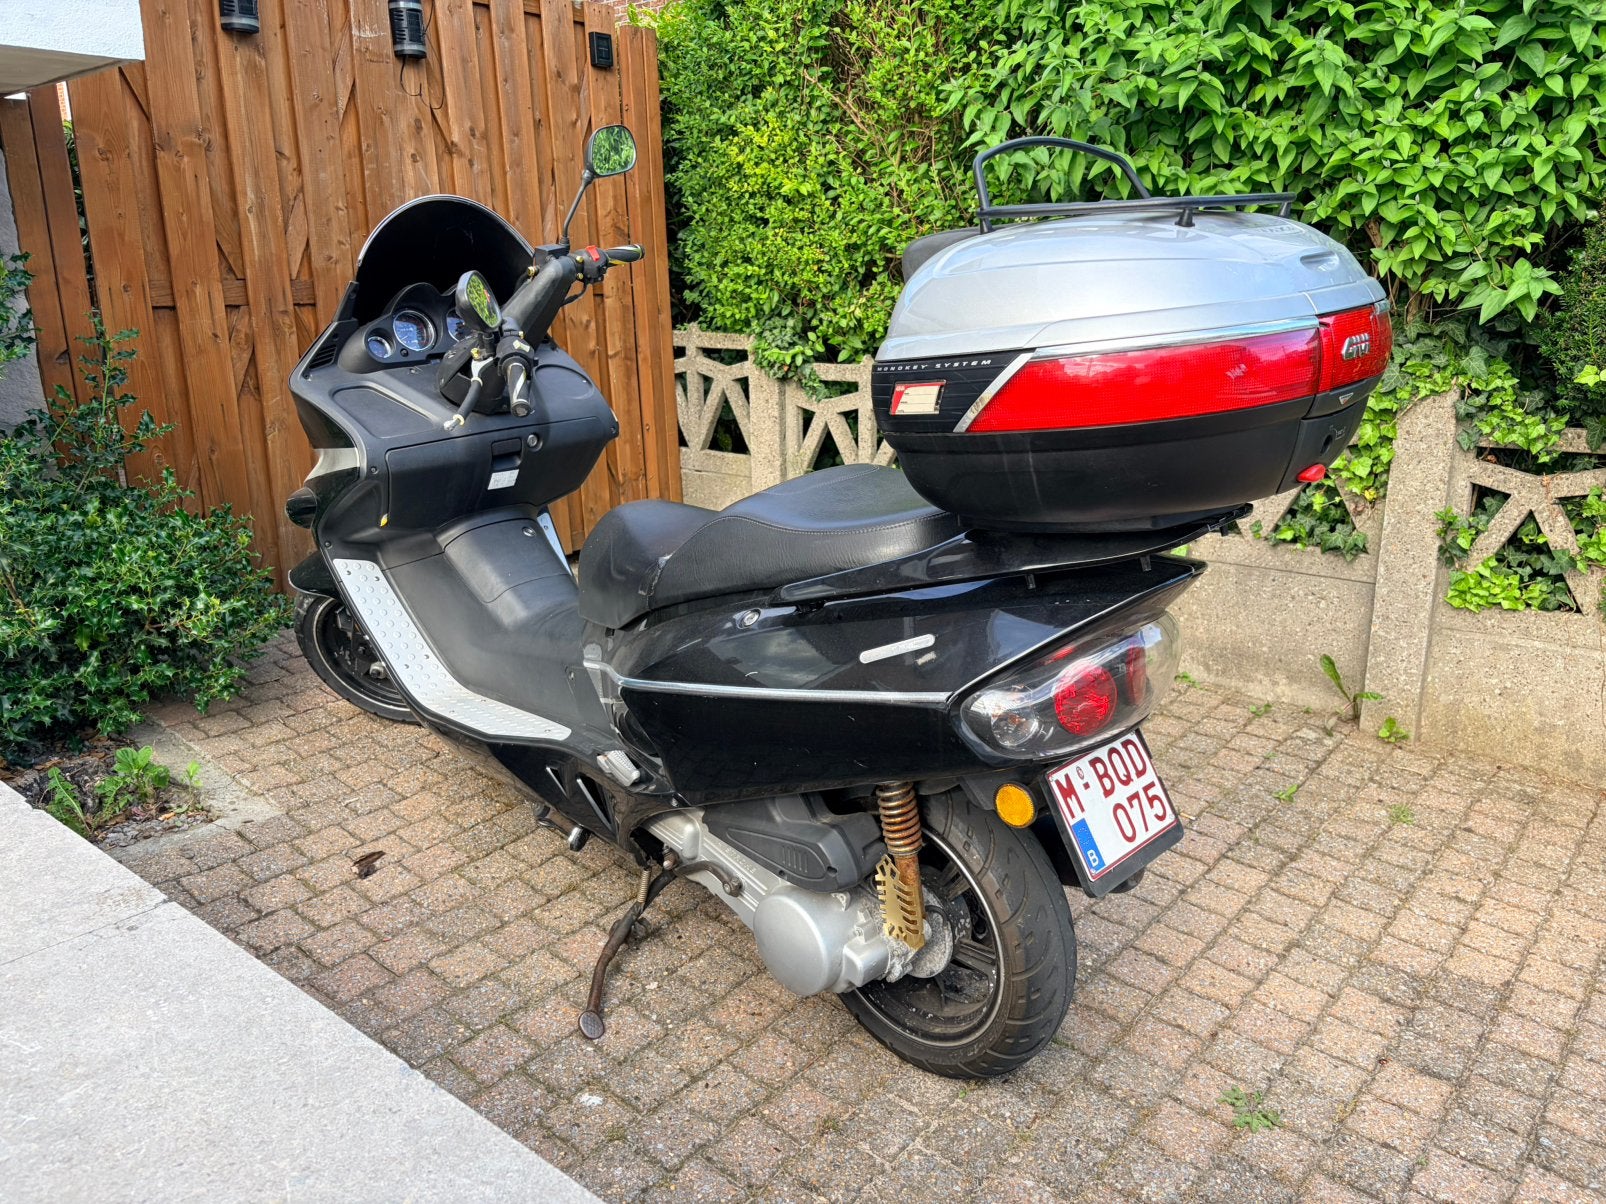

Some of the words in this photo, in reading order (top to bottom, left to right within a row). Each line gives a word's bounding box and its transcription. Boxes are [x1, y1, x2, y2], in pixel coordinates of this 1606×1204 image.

[876, 364, 929, 372] MONOKEY
[934, 359, 992, 369] SYSTEM
[1112, 781, 1167, 843] 075
[1087, 849, 1099, 867] B
